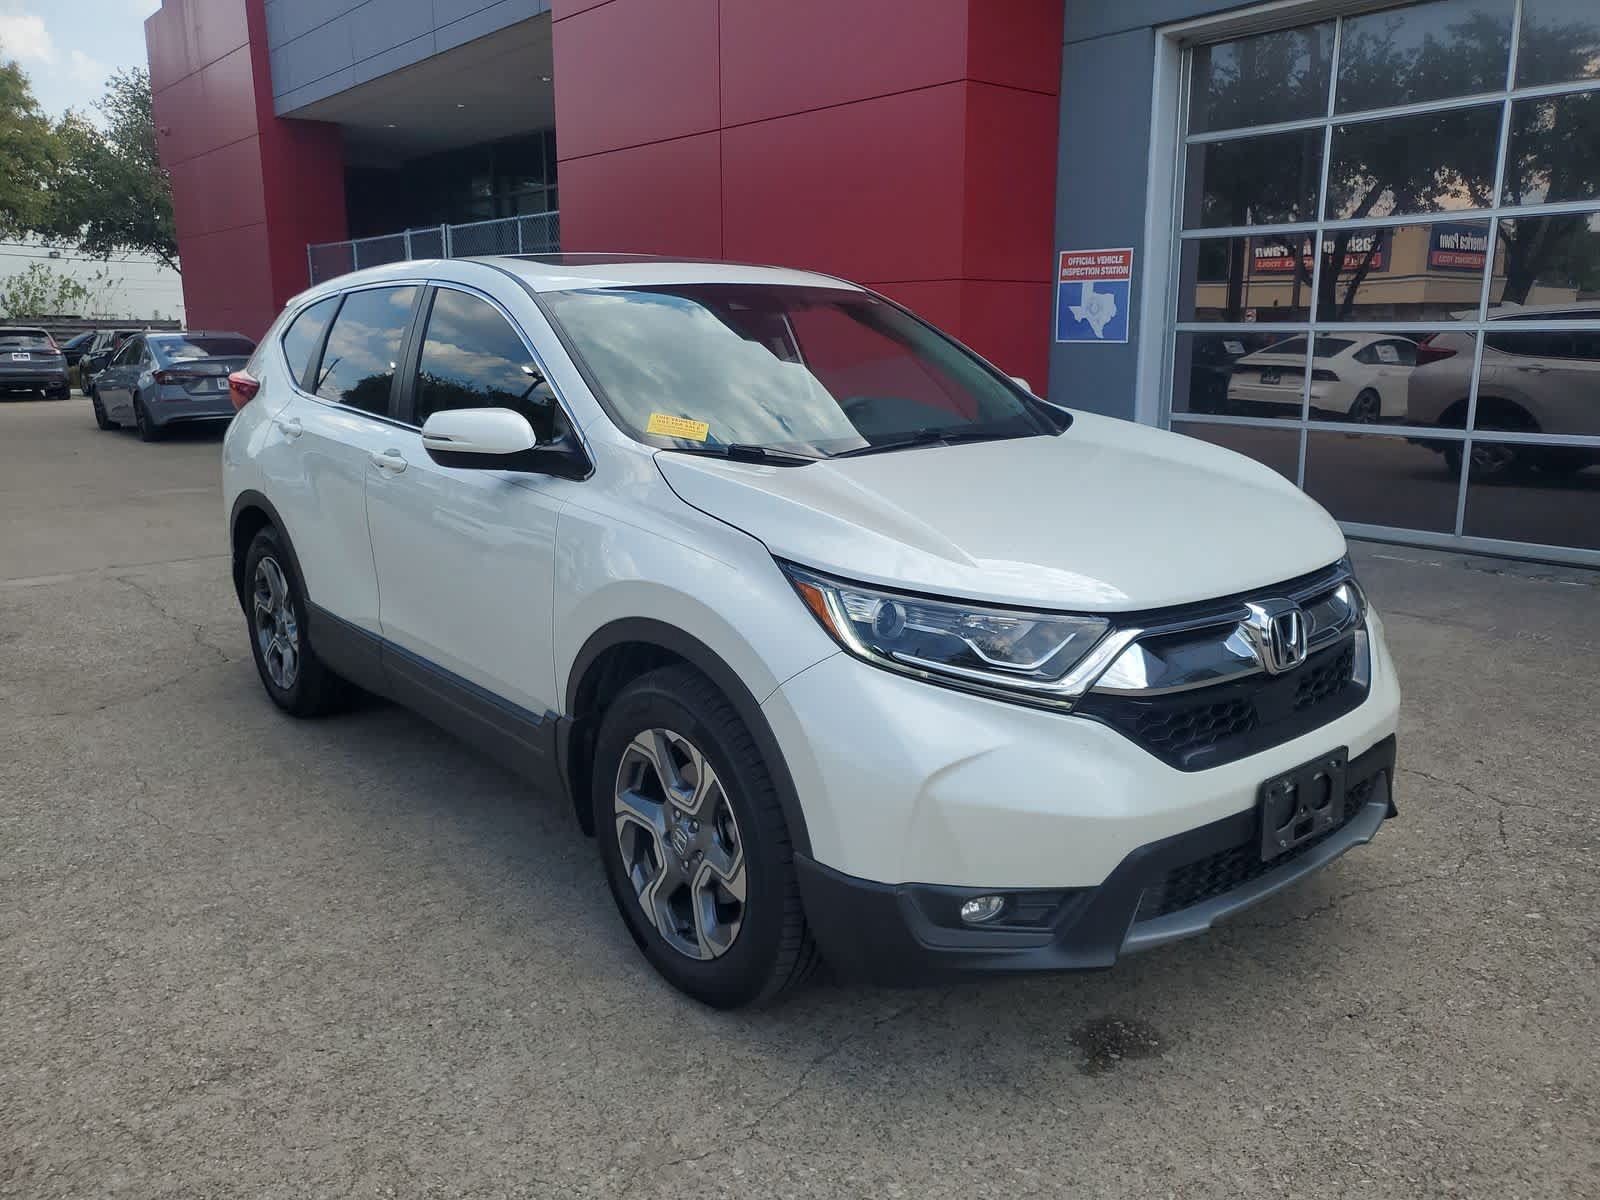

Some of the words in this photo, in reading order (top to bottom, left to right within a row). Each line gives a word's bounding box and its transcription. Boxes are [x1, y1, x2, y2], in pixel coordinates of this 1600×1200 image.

[1068, 256, 1096, 266] OFFICIAL
[1097, 255, 1124, 264] VEHICLE
[1062, 267, 1100, 276] INSPECTION
[1101, 266, 1129, 275] STATION
